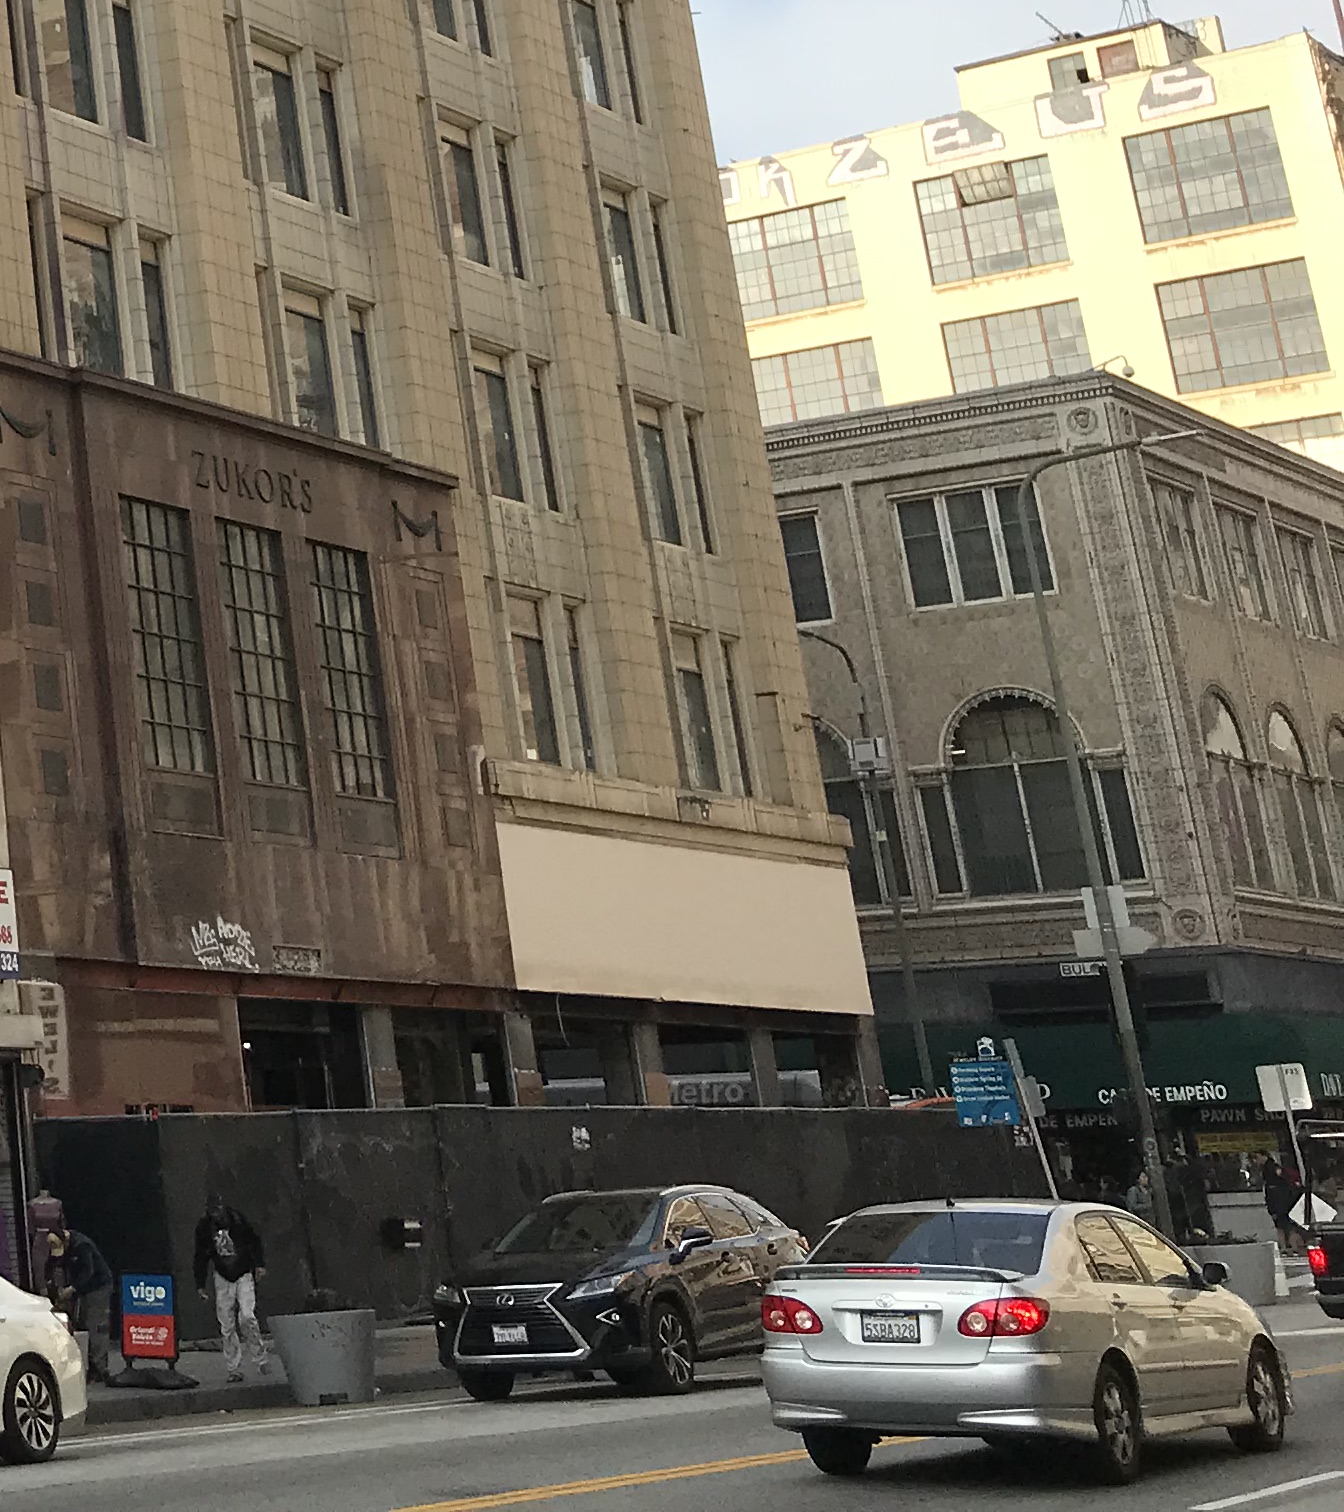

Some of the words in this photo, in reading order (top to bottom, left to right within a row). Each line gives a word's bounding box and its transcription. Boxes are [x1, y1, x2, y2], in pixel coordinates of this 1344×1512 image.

[192, 450, 311, 514] ZUKOR'S
[1061, 964, 1095, 975] BUL
[1165, 1080, 1228, 1102] EMPEÑO
[1065, 1113, 1118, 1128] EMPE
[1200, 1108, 1246, 1123] PAWN
[1255, 1107, 1288, 1122] SHO
[129, 1281, 166, 1302] vigo
[865, 1322, 916, 1339] 5SBA328
